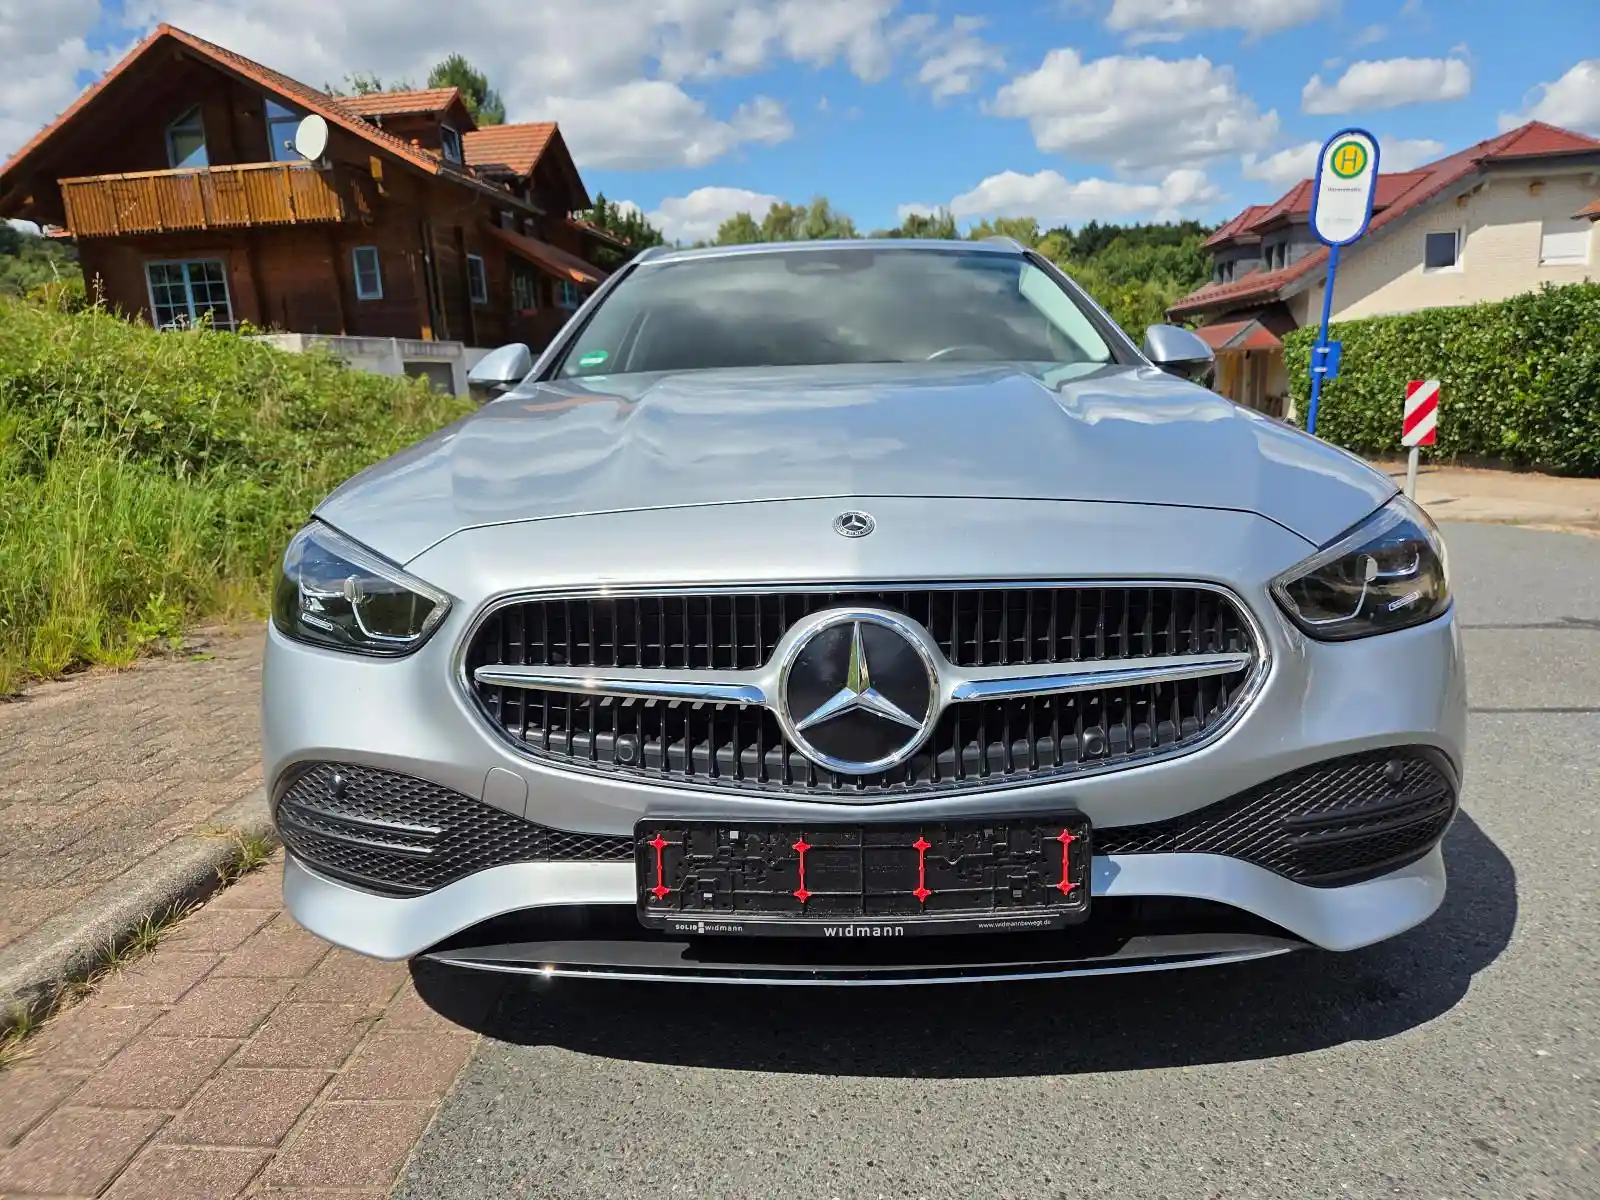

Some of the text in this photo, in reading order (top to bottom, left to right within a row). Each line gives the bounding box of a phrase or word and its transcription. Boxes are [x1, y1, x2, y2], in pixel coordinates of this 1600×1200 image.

[1341, 149, 1358, 170] H
[823, 924, 904, 937] widmann
[978, 919, 1052, 929] www.widmannbewegt.de
